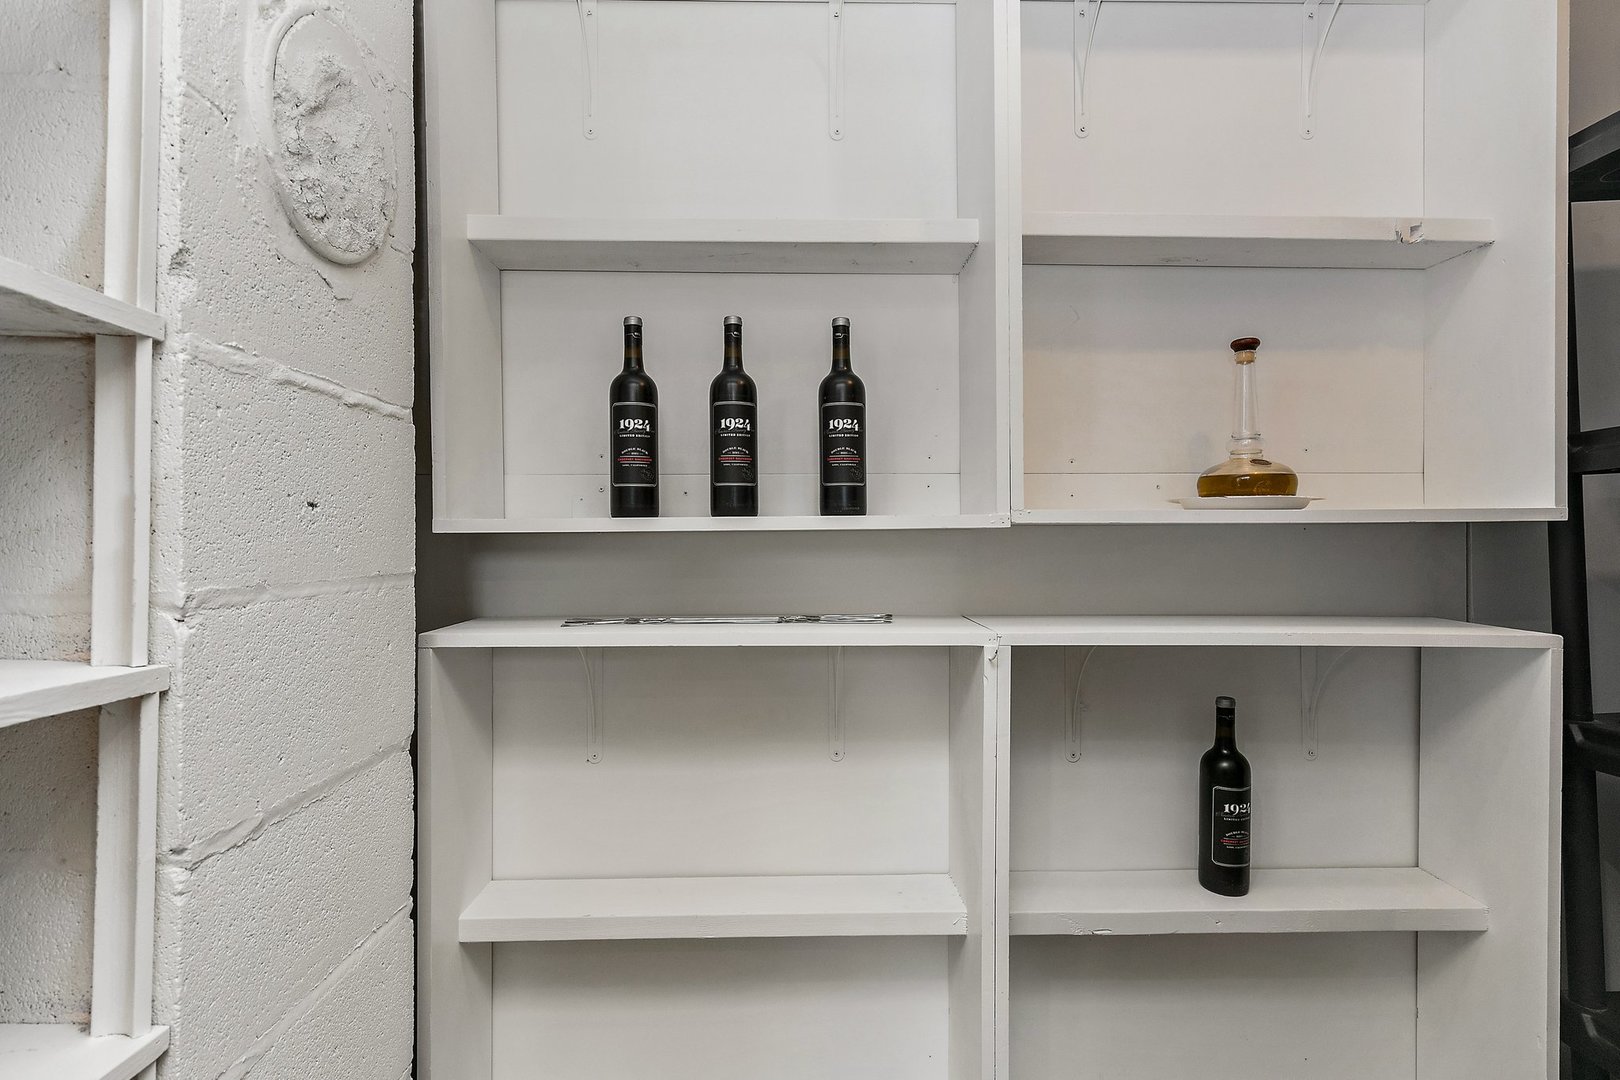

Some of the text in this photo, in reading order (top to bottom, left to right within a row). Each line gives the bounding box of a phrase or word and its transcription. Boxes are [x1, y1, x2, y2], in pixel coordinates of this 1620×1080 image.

[619, 418, 650, 432] 1924
[720, 418, 750, 431] 1924
[829, 418, 859, 432] 1924
